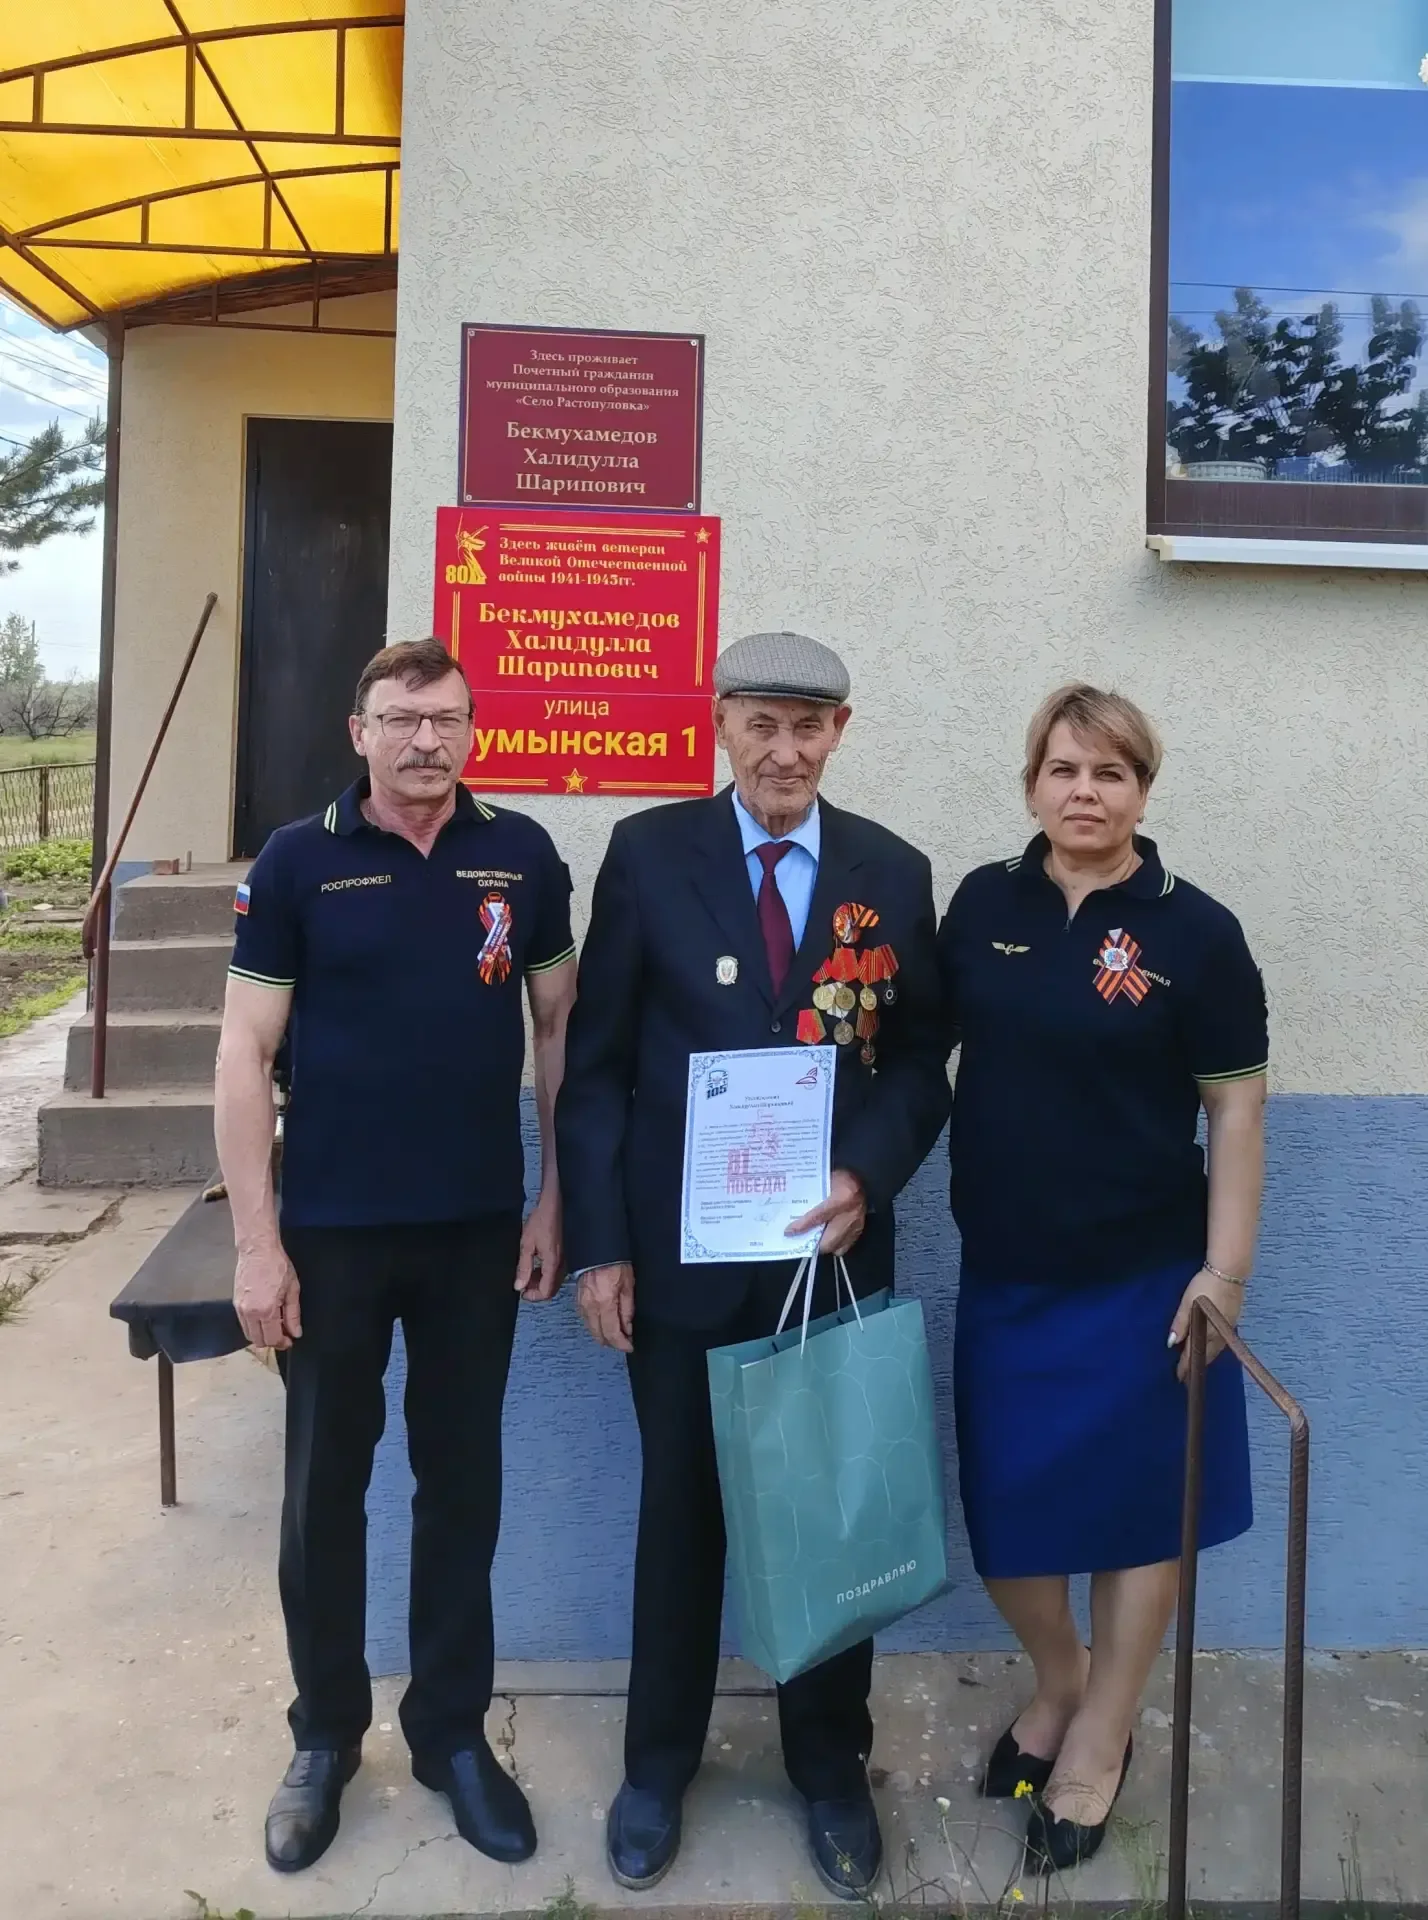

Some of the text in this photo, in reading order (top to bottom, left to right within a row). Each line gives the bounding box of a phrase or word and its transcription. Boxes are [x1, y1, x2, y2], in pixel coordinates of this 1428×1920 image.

[530, 349, 639, 366] Здесь проживает
[513, 364, 654, 381] Почетный гражданин
[486, 380, 679, 397] муниципального образования
[515, 395, 650, 412] «Село Растопуловка»
[507, 421, 658, 445] Бекмухамедов
[523, 448, 640, 471] Халидулла
[516, 473, 646, 495] Шарипович
[499, 537, 665, 556] Здесь живёт ветеран
[499, 554, 688, 572] Великой Отечественной
[445, 565, 468, 584] 80
[498, 572, 546, 584] войны
[479, 602, 680, 631] Бекмухамедов
[505, 629, 652, 657] Халидулла
[497, 655, 659, 681] Шарипович
[544, 698, 609, 720] улица
[475, 725, 696, 761] умынская 1
[321, 874, 392, 893] РОСПРОФЖЕЛ
[456, 869, 523, 881] ВЕДОМСТВЕННАЯ
[477, 879, 509, 888] ОХРАНА
[706, 1085, 727, 1100] 105
[836, 1559, 917, 1604] ПОЗДРАВЛЯЮ
